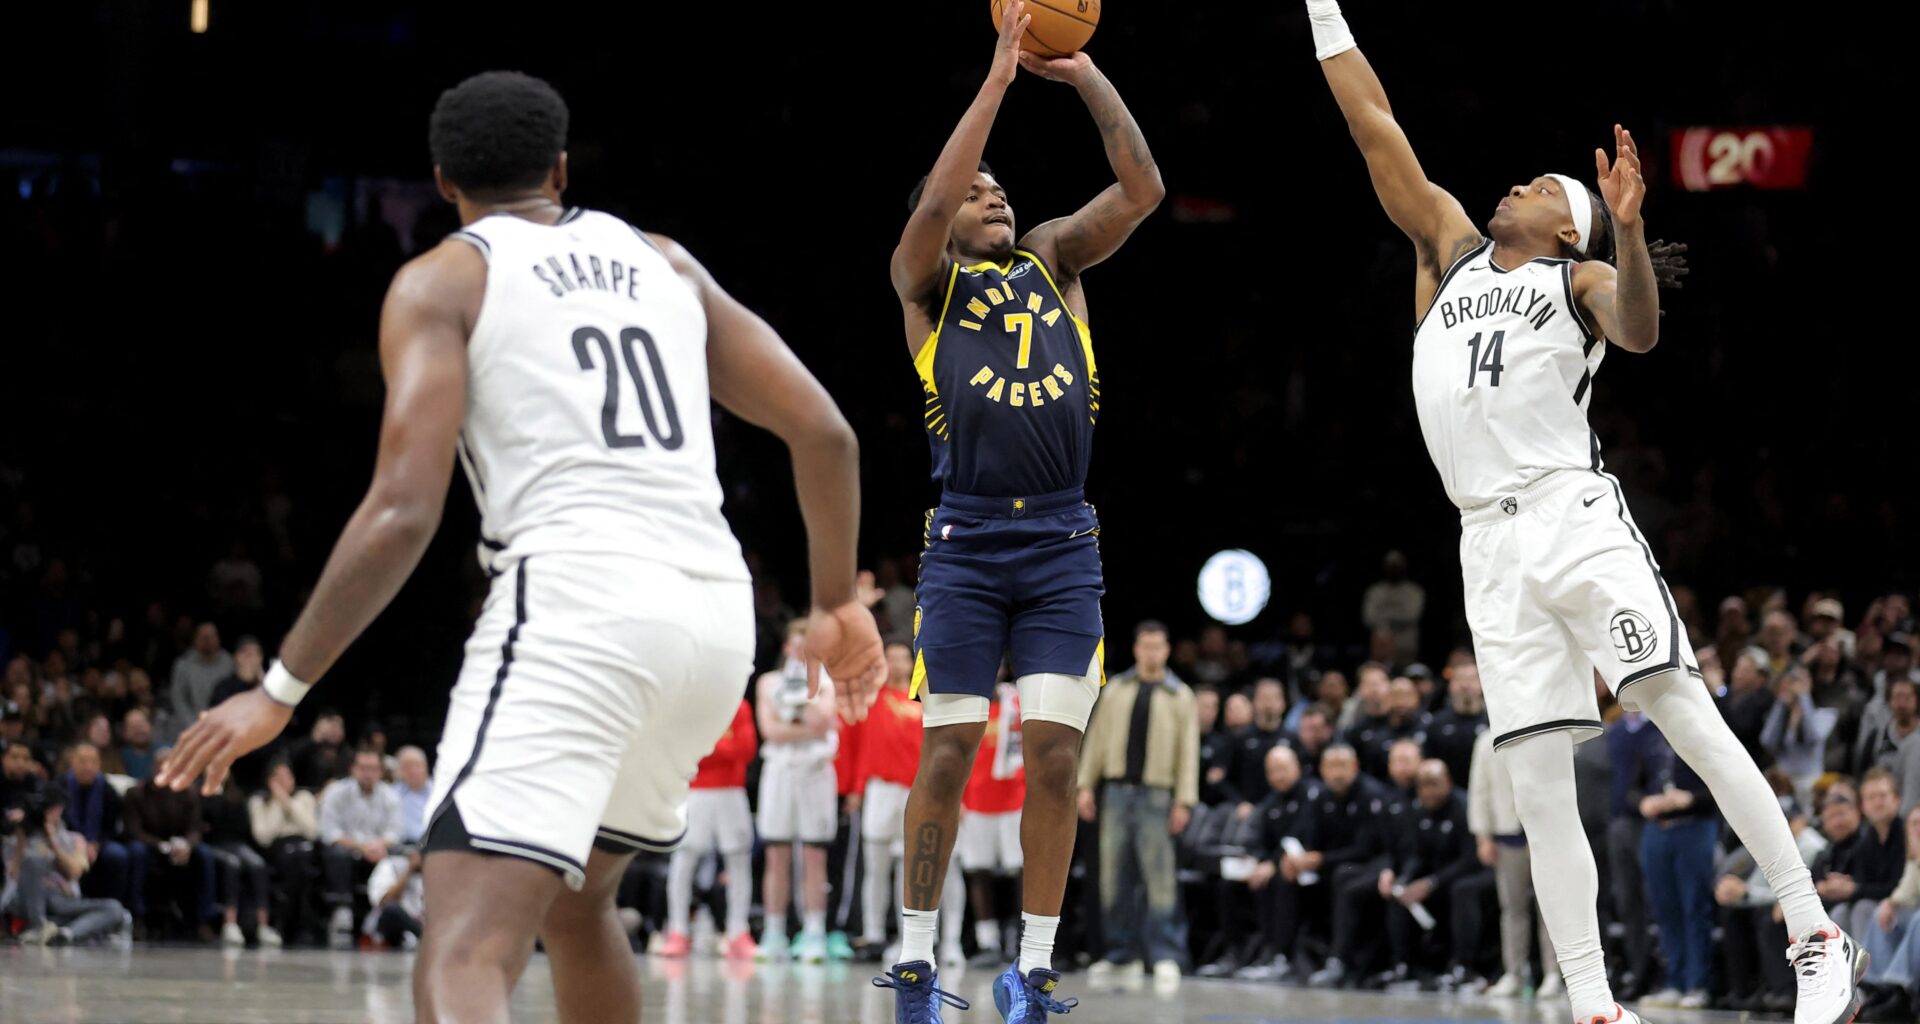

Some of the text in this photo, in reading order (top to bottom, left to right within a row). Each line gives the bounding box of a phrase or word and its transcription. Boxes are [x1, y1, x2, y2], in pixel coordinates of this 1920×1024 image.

[533, 253, 640, 300] SHARPE
[959, 281, 1062, 332] INDINA
[1440, 286, 1557, 331] BROOKLYN
[1004, 313, 1033, 370] 7
[1467, 330, 1505, 389] 14
[571, 326, 684, 450] 20
[969, 363, 1074, 407] PACERS
[1619, 618, 1643, 655] B
